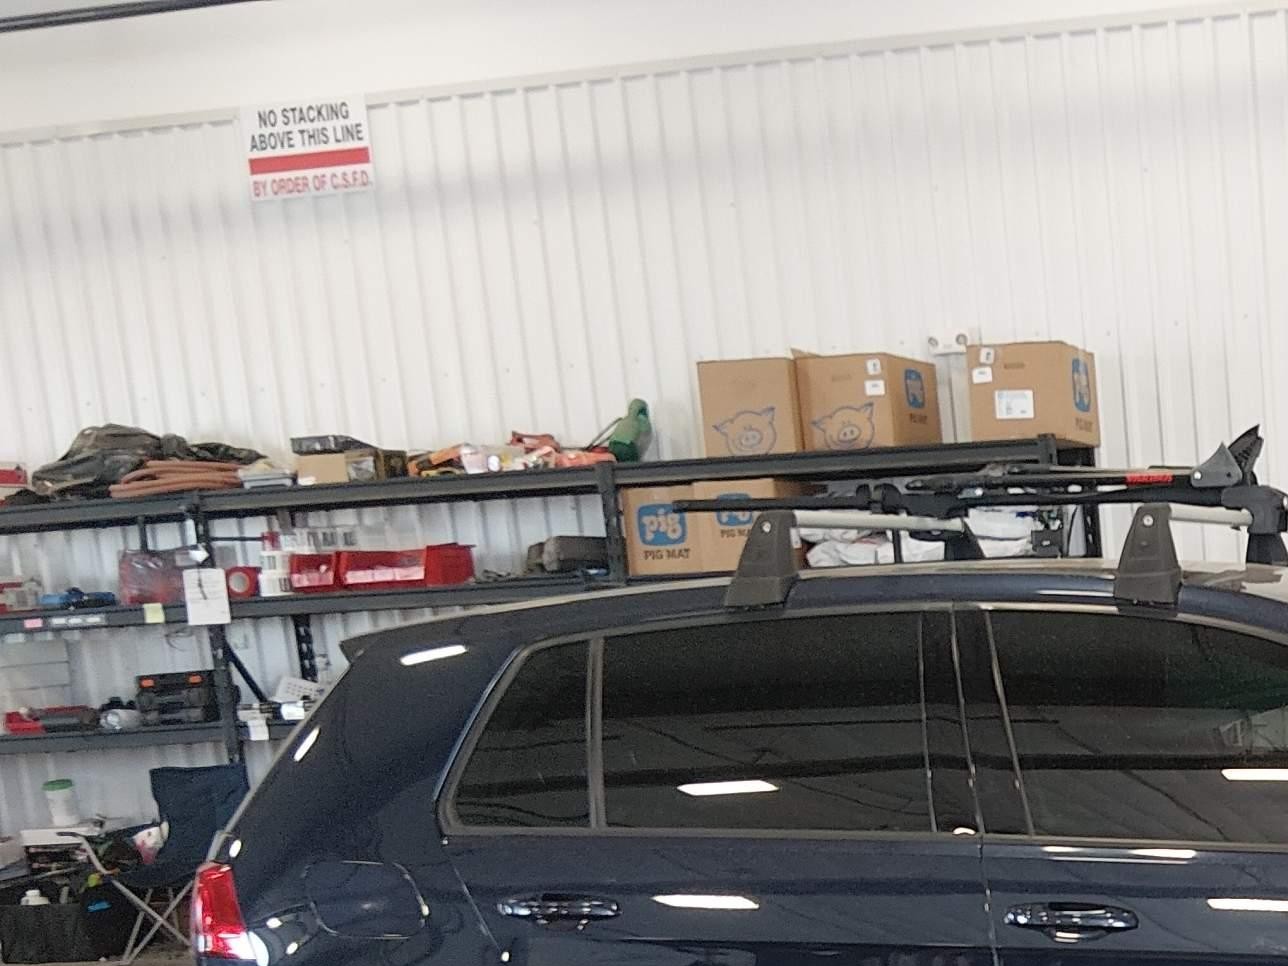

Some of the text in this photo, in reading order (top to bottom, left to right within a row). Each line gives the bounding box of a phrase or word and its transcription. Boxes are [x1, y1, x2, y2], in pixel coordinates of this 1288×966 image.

[258, 102, 350, 128] NO STACKING
[250, 123, 364, 152] ABOVE THIS LINE
[253, 179, 268, 197] BY
[271, 176, 309, 195] ORDER
[313, 174, 327, 191] OF
[643, 548, 691, 560] PIG MAT
